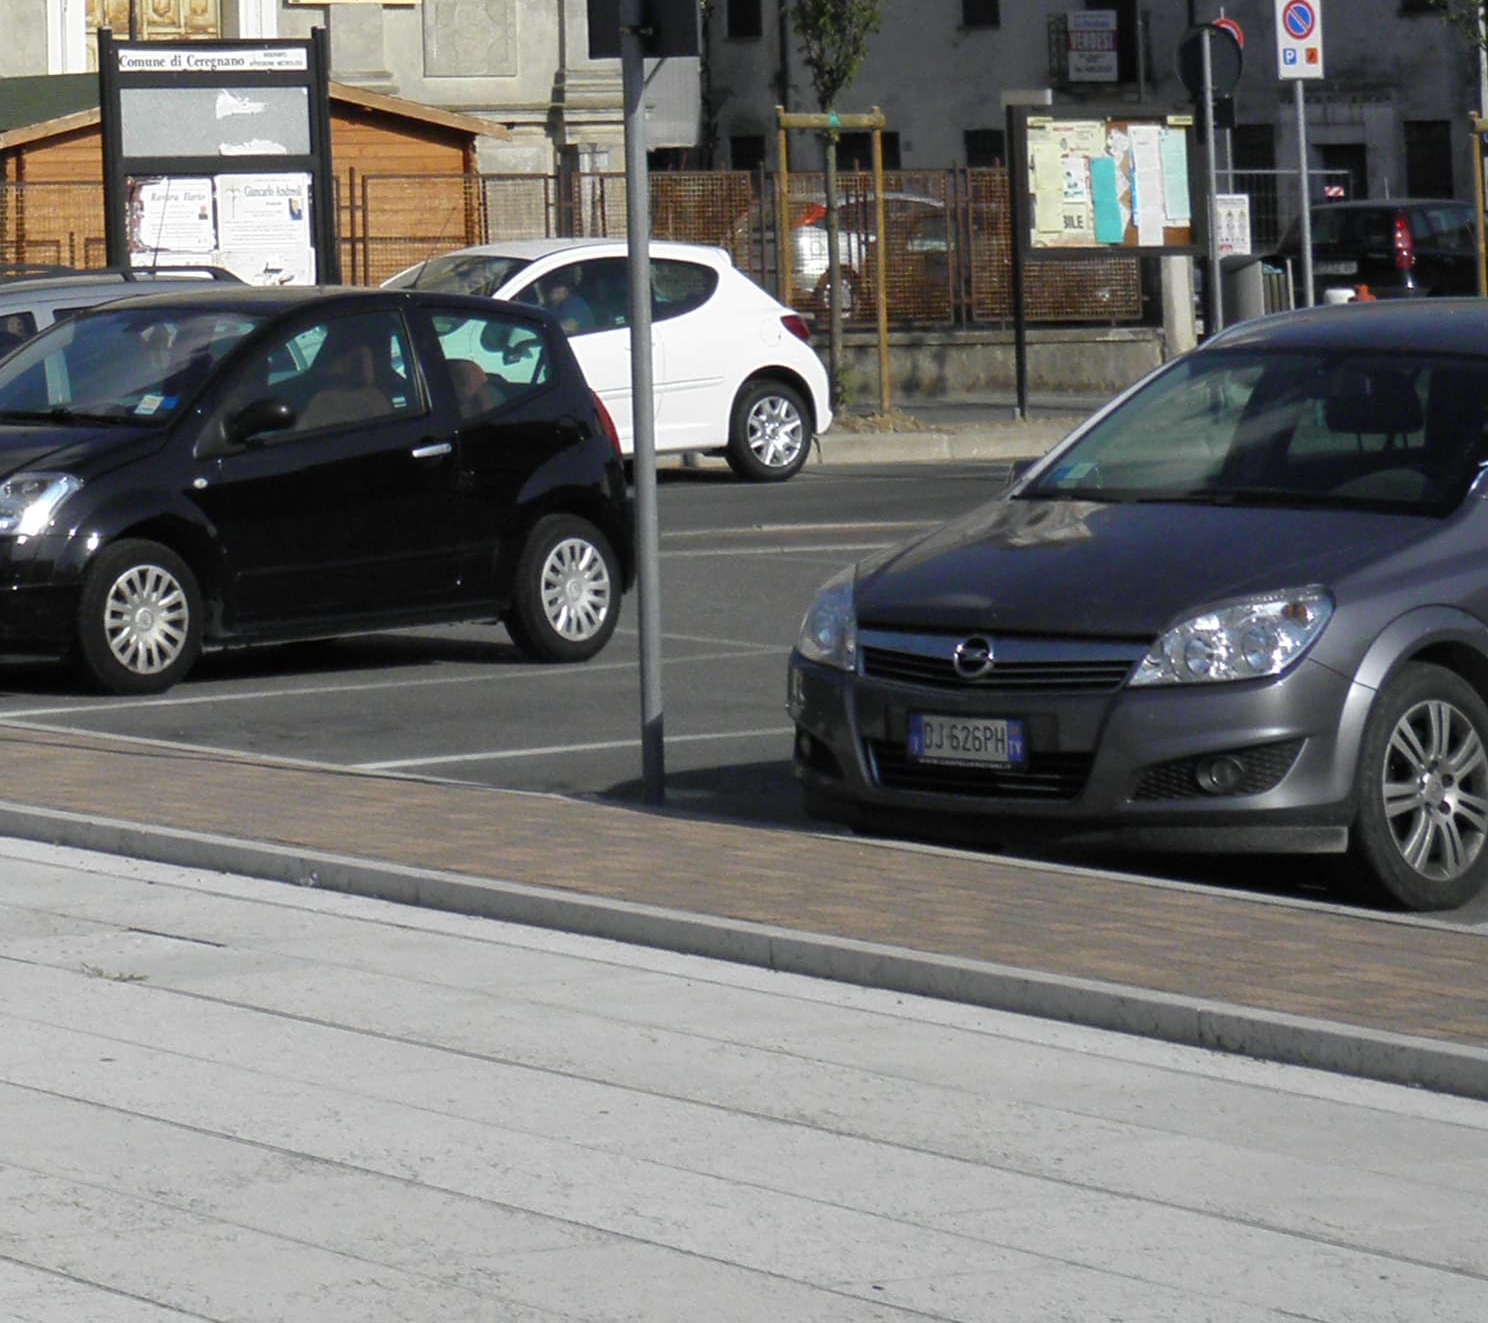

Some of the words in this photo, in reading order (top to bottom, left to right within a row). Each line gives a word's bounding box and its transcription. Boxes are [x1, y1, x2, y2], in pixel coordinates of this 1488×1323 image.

[119, 54, 165, 68] Comune
[170, 54, 182, 68] di
[186, 54, 245, 71] Ceregnano
